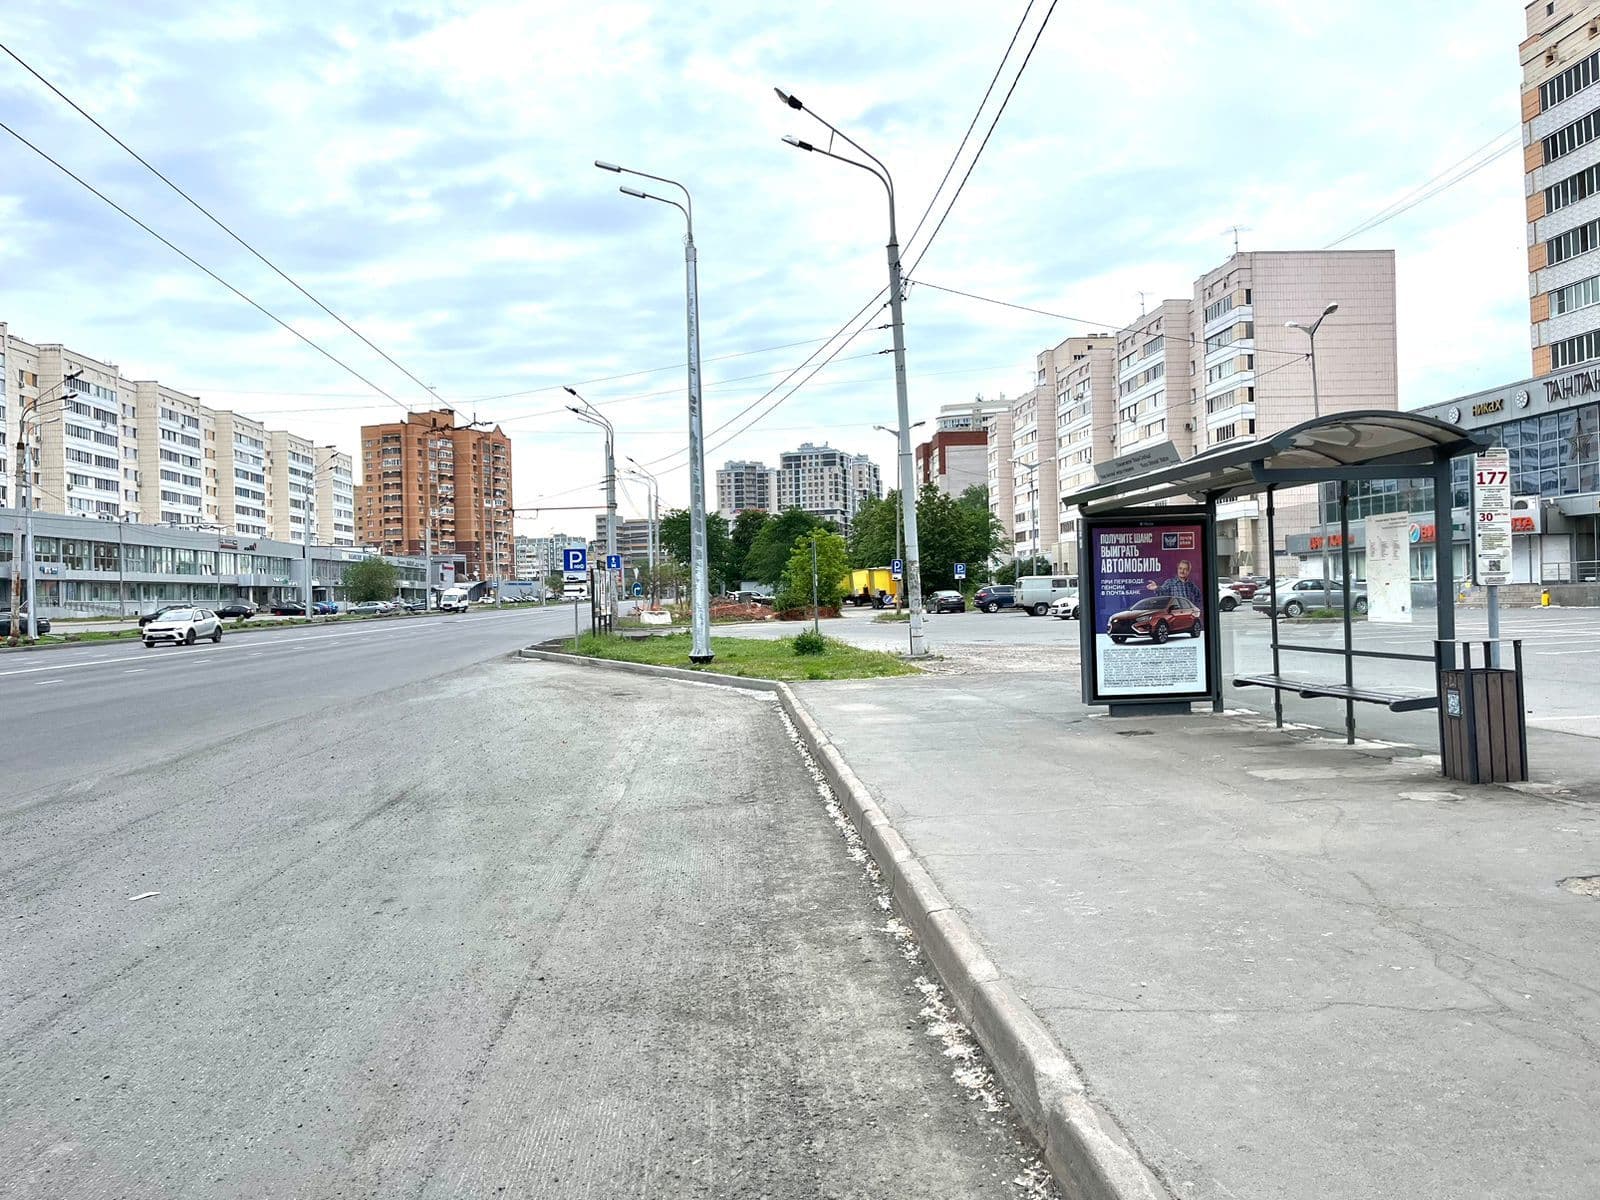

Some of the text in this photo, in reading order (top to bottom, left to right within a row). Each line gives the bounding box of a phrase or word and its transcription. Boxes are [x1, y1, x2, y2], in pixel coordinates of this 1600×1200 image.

[1476, 471, 1508, 485] 177
[1479, 512, 1494, 522] 30
[1100, 533, 1153, 545] ПОЛУЧИТЕ ШАНС
[1100, 545, 1140, 558] ВЫИГРАТЬ
[569, 551, 583, 569] P
[1101, 557, 1162, 573] АВТОМОБИЛЬ
